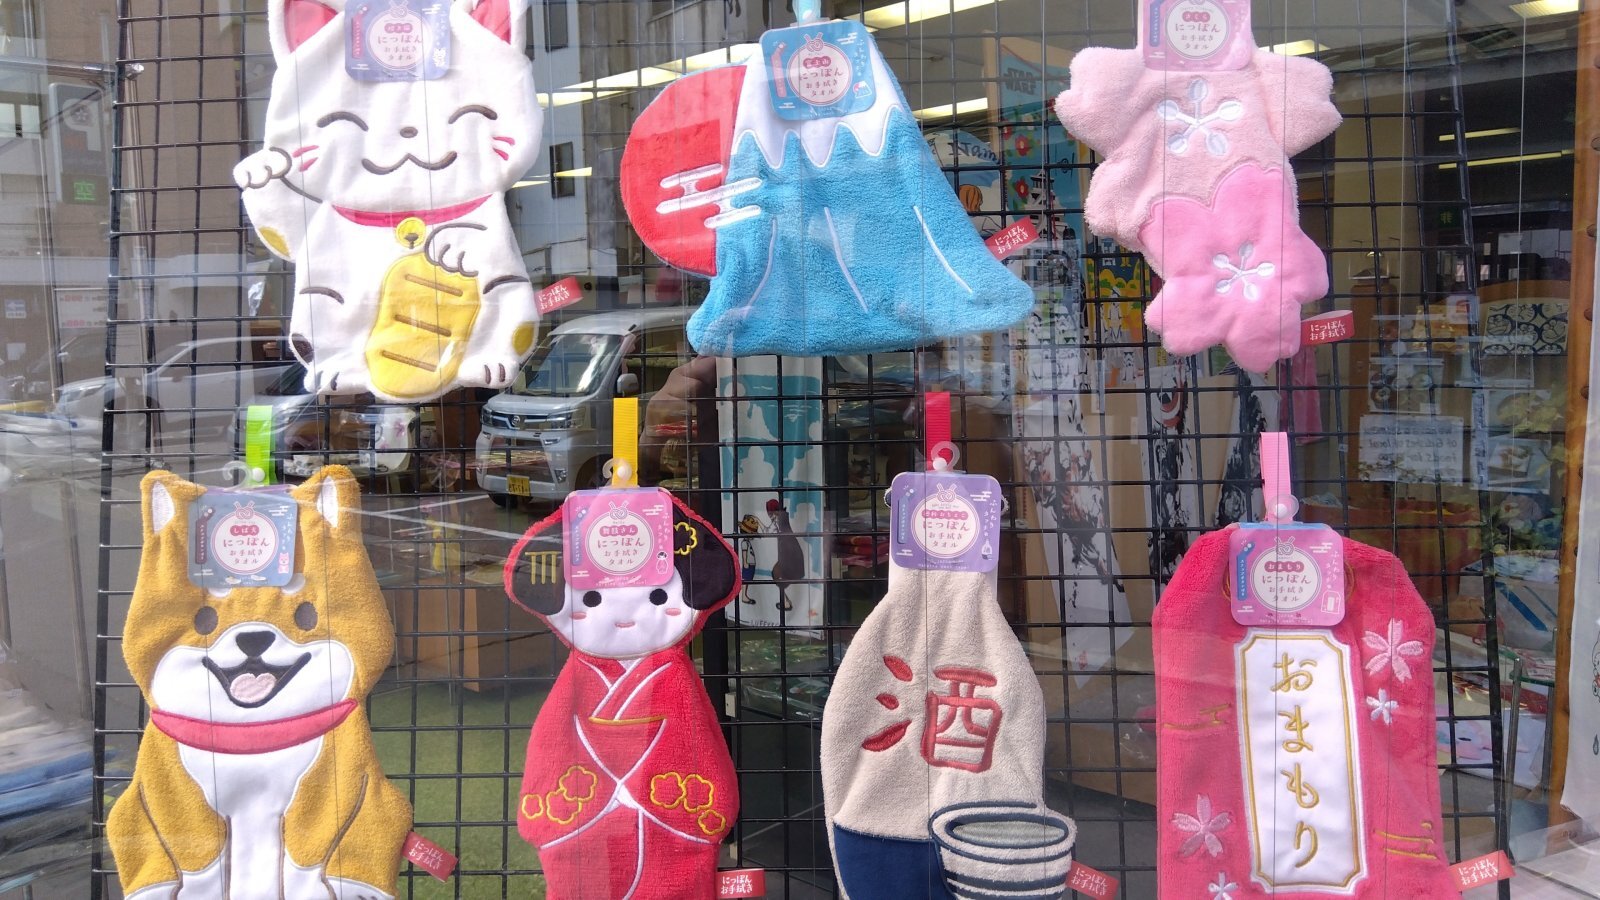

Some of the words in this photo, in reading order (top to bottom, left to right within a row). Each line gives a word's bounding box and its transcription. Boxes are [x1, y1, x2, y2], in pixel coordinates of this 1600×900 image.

[1175, 23, 1221, 33] にっぽん
[378, 34, 422, 45] にっぽん
[1181, 34, 1214, 42] お手拭き
[1185, 43, 1209, 51] タオル
[799, 67, 843, 81] にっぽん
[805, 80, 838, 89] お手拭き
[811, 89, 836, 97] タオル
[994, 225, 1025, 246] にっぽん
[997, 230, 1029, 254] お手拭き
[538, 284, 567, 302] にっぽん
[540, 289, 570, 310] お手拭き
[1310, 320, 1345, 332] にっぽん
[1309, 327, 1346, 341] お手拭き
[232, 526, 259, 535] しば犬
[922, 521, 970, 532] にっぽん
[928, 532, 963, 540] お手拭き
[222, 537, 270, 548] にっぽん
[597, 537, 645, 549] にっぽん
[931, 540, 959, 548] タオル
[229, 548, 264, 557] お手拭き
[603, 548, 639, 557] お手拭き
[608, 558, 635, 566] タオル
[1267, 562, 1302, 571] おまもり
[1261, 574, 1312, 584] にっぽん
[1268, 585, 1305, 594] お手拭き
[1272, 595, 1300, 603] タオル
[861, 655, 1003, 774] 酒
[1270, 652, 1320, 868] おまもり
[415, 840, 443, 862] にっぽん
[408, 847, 441, 870] お手拭き
[1458, 858, 1495, 876] にっぽん
[722, 874, 753, 885] にっぽん
[1076, 867, 1108, 886] にっぽん
[1460, 865, 1499, 886] お手拭き
[720, 883, 753, 895] お手拭き
[1071, 874, 1106, 896] お手拭き
